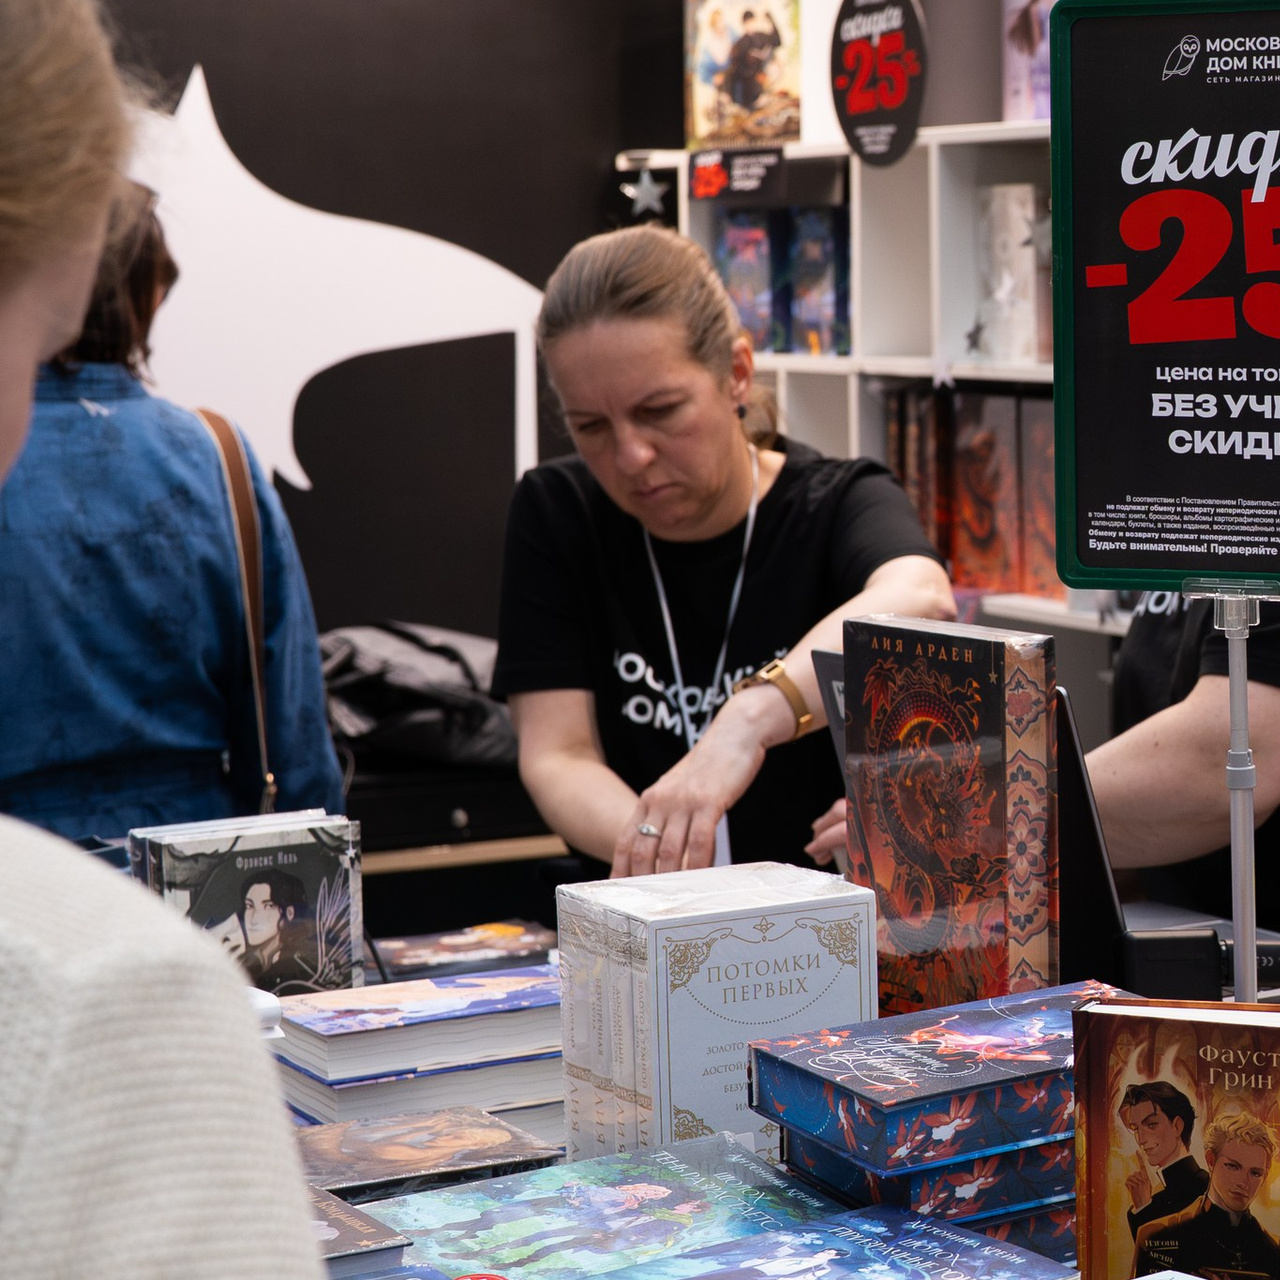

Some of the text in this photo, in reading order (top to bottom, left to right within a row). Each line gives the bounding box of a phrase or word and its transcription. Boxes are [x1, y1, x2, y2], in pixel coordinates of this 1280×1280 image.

[1207, 56, 1248, 73] ДОМ
[1156, 366, 1212, 382] цена
[1219, 367, 1247, 381] на
[1151, 393, 1217, 418] БЕЗ
[1089, 539, 1127, 551] Будьте
[1129, 541, 1208, 553] внимательны!
[1210, 543, 1278, 557] Проверяйте
[871, 636, 973, 662] ЛИЯ АРДЕН
[707, 952, 821, 983] ПОТОМКИ
[723, 977, 808, 1004] ПЕРВЫХ
[706, 1042, 744, 1055] ЗОЛОТО
[651, 1150, 688, 1174] ТЕНЬ
[731, 1152, 788, 1189] АНТОНИНА
[714, 1171, 770, 1205] ШОЛОХ
[910, 1220, 981, 1248] АНТОНИНА
[898, 1238, 962, 1266] ШОЛОХ
